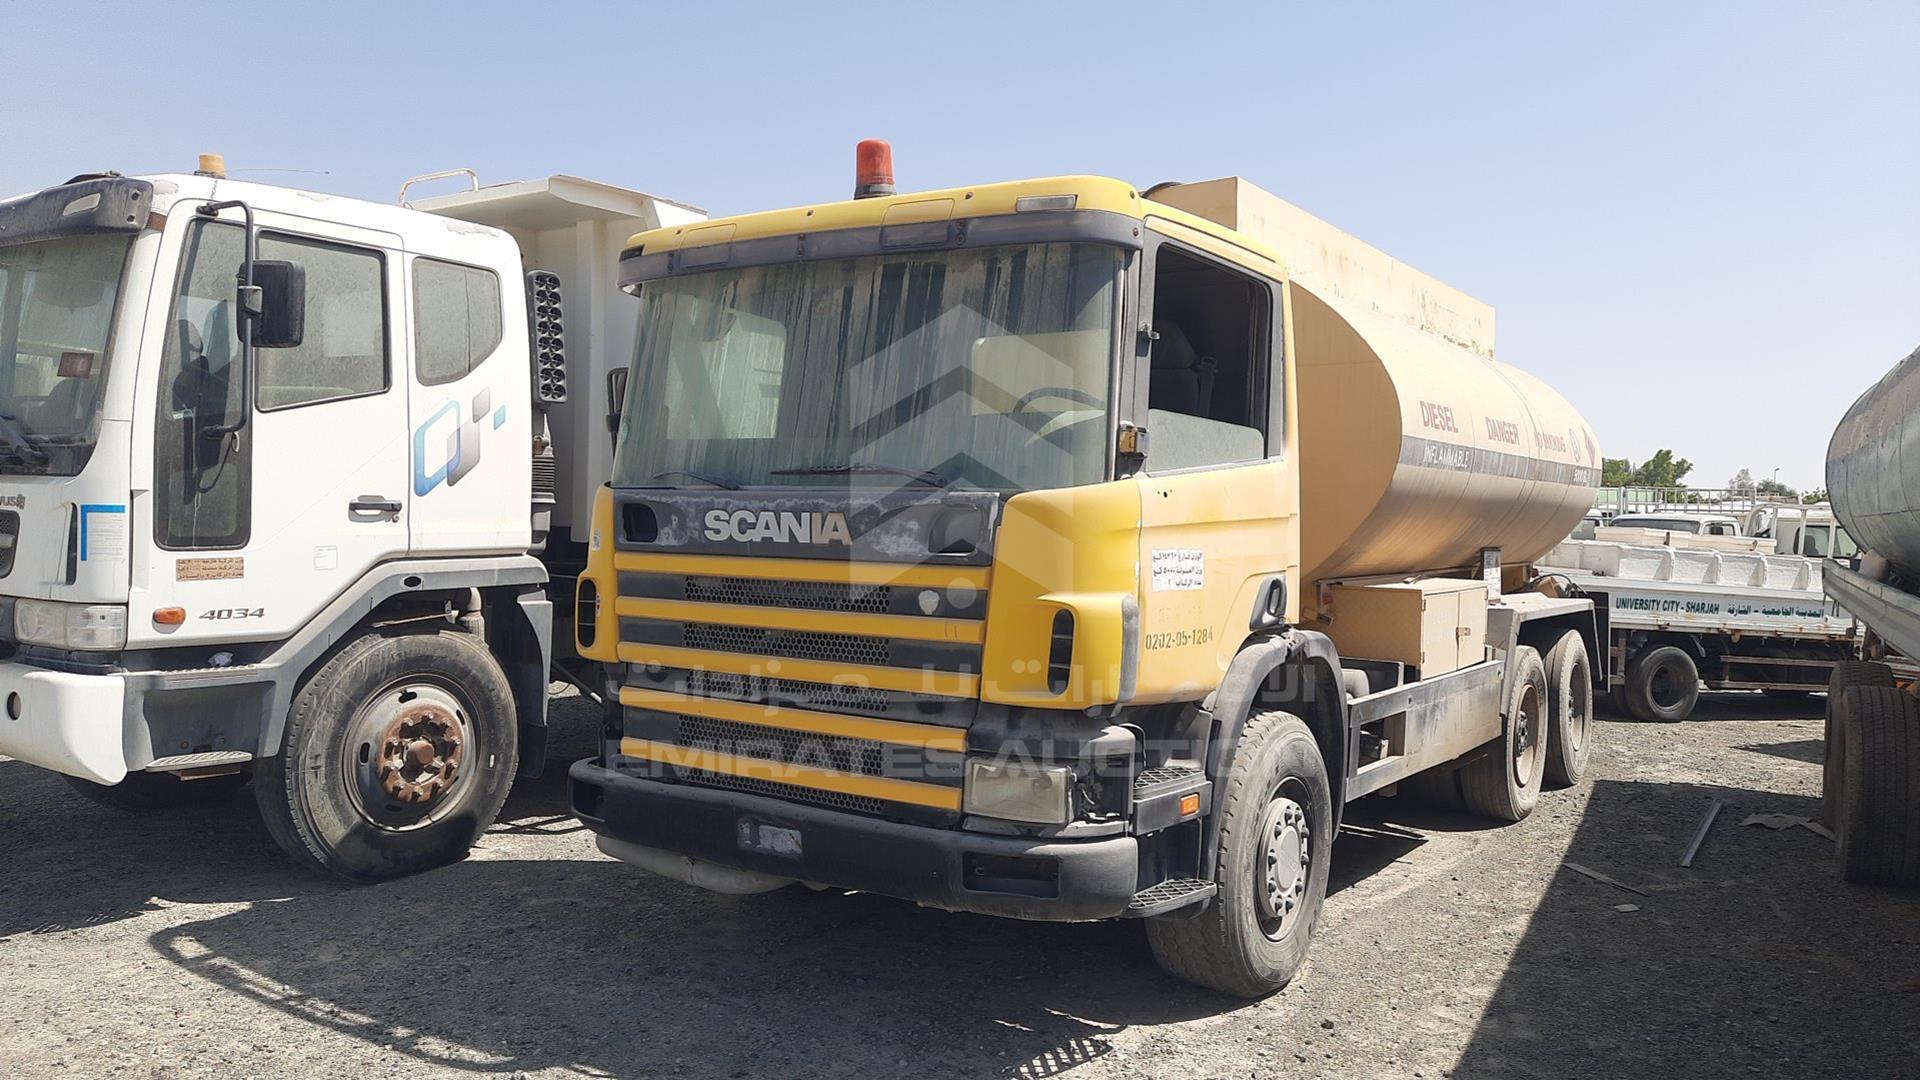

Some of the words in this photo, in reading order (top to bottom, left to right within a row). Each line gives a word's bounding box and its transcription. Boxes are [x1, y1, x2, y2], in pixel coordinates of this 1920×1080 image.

[1419, 400, 1459, 433] DIESEL
[1485, 417, 1520, 445] DANGER
[703, 509, 853, 546] SCANIA
[198, 607, 265, 621] 4034
[1615, 597, 1661, 612] UNIVERSITY
[1661, 599, 1681, 613] CITY
[1685, 601, 1720, 615] SHARJAH
